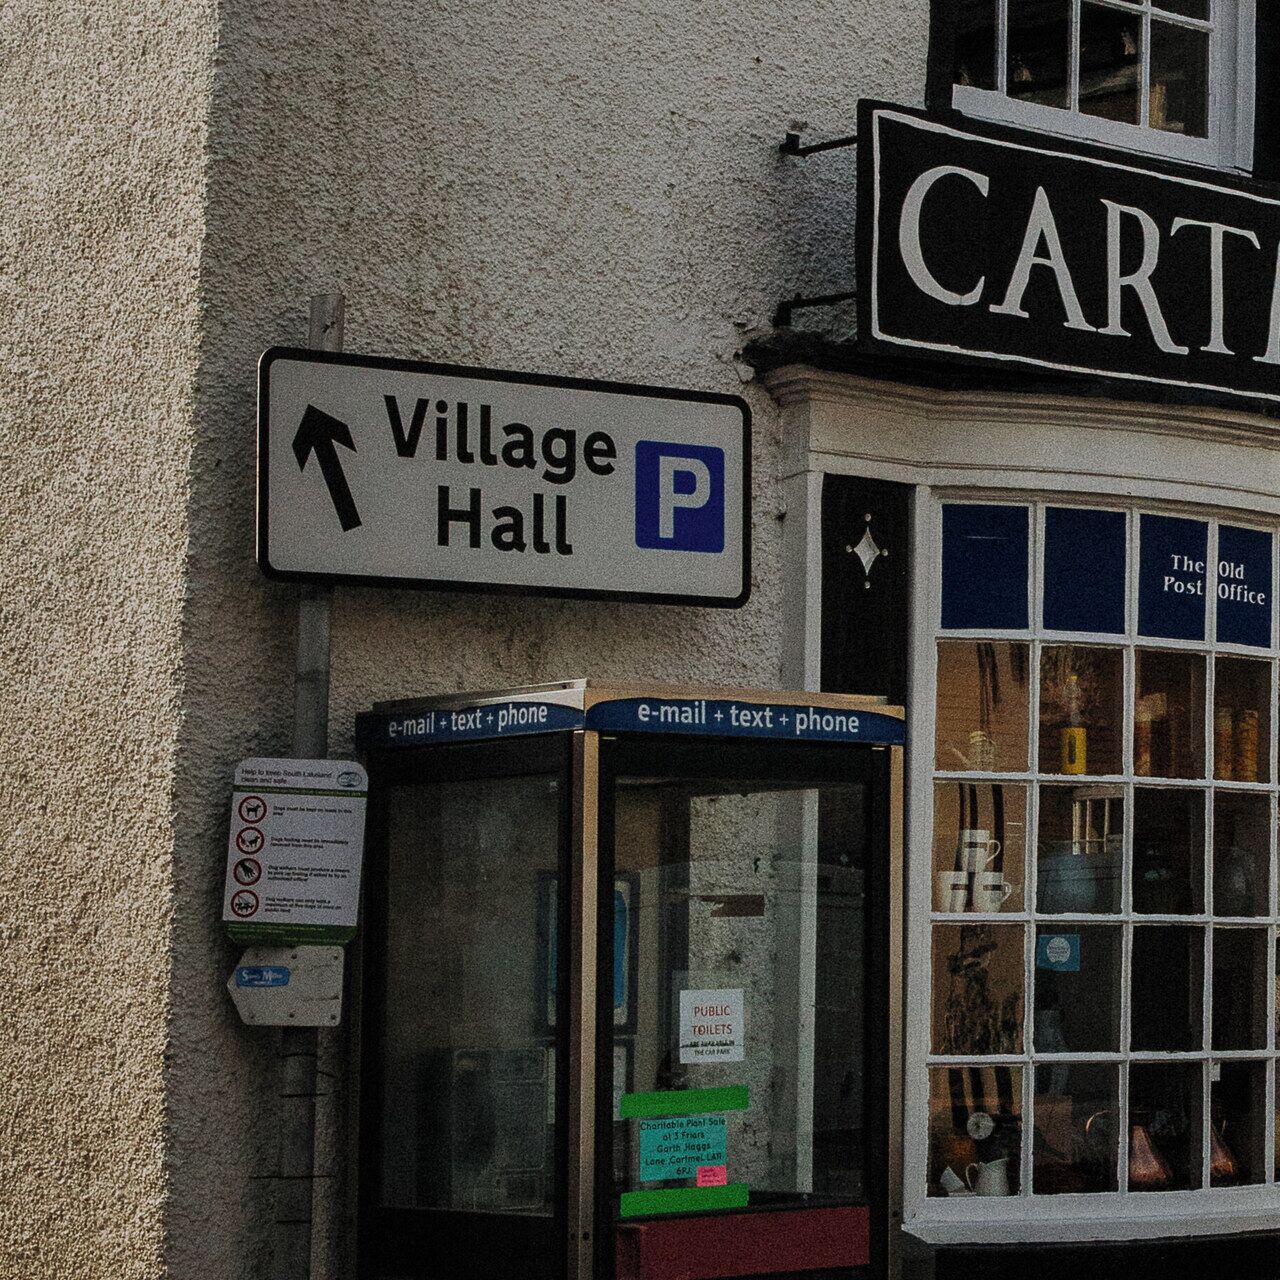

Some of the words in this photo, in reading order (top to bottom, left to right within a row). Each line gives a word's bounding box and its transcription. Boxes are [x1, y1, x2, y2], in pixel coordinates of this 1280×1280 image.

[384, 394, 617, 484] Village
[659, 456, 711, 538] P
[437, 485, 573, 556] Hall
[1171, 554, 1204, 574] The
[1218, 561, 1244, 580] Old
[1163, 576, 1204, 596] Post
[1218, 583, 1266, 605] Office
[389, 712, 435, 737] e-mail
[451, 709, 482, 731] text
[498, 704, 547, 731] phone
[638, 701, 706, 724] e-mail
[730, 705, 774, 728] text
[796, 707, 860, 735] phone
[694, 1005, 730, 1017] PUBLIC
[691, 1024, 733, 1036] TOILETS
[641, 1120, 684, 1131] Charitable
[687, 1118, 705, 1127] Plant
[709, 1117, 726, 1126] Sale
[645, 1158, 666, 1166] Lane
[657, 1144, 681, 1153] Garth
